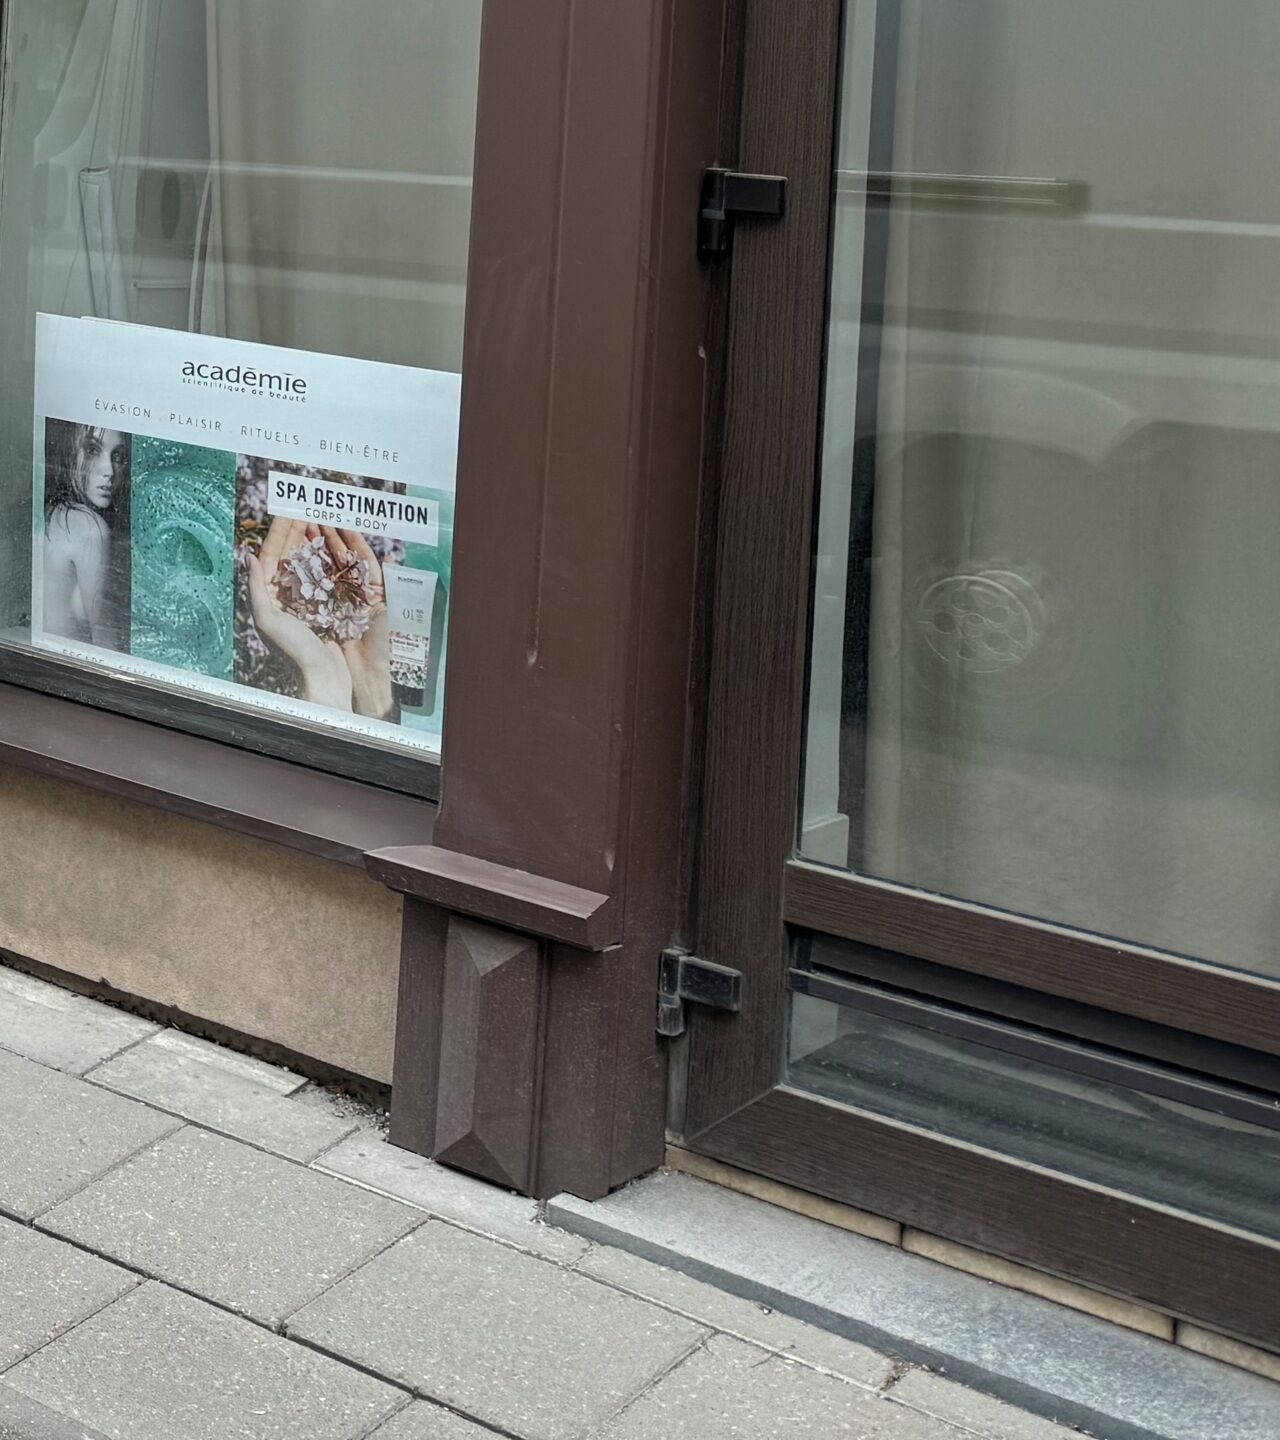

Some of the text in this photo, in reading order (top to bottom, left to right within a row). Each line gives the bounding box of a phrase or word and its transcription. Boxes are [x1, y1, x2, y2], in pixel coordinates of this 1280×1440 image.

[95, 398, 400, 463] ÉVASION PLAISIR RITUELS BIEN-ÊTRE
[276, 480, 428, 525] SPA DESTINATION
[305, 507, 342, 523] CORPS
[355, 517, 388, 531] BODY
